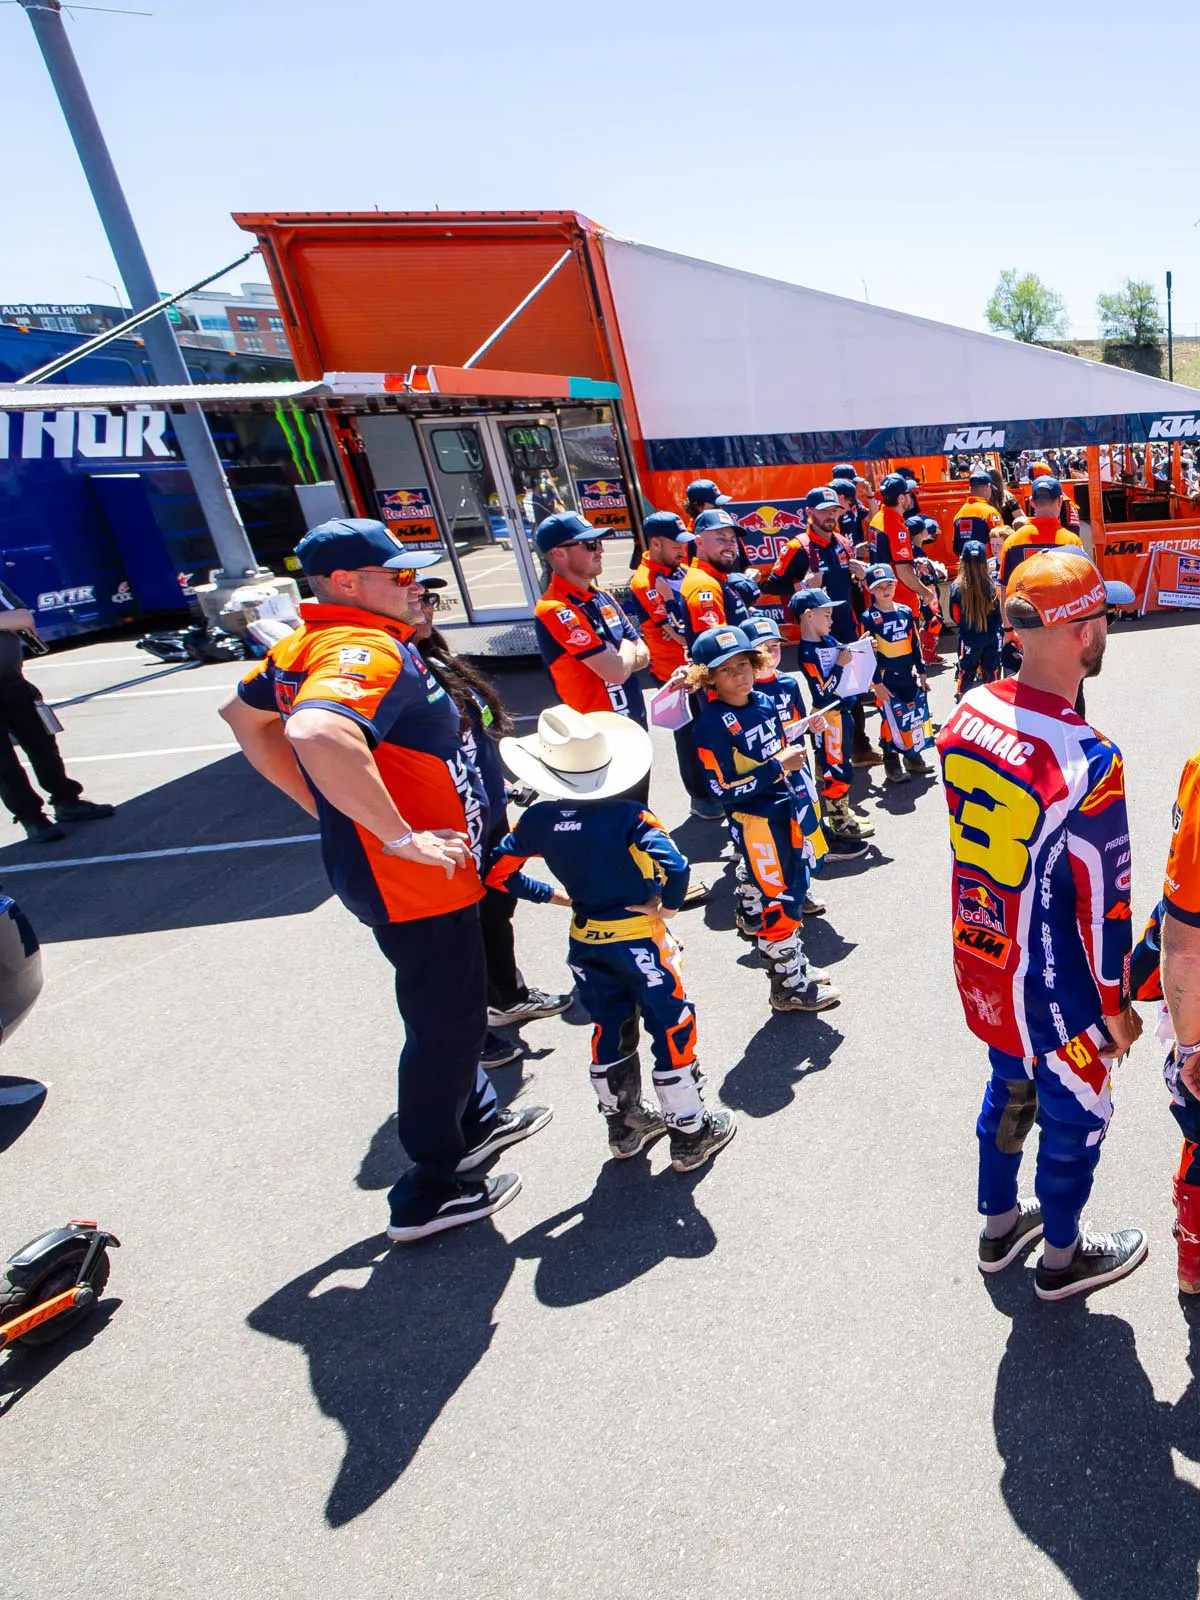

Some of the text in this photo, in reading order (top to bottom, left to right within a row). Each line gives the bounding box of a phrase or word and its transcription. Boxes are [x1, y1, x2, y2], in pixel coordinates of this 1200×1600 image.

[2, 306, 92, 315] ALTA MILE HIGH
[0, 410, 170, 458] HOR
[944, 426, 1005, 450] KTM
[383, 504, 433, 519] Red Bull
[583, 498, 605, 509] Red
[594, 514, 626, 525] KTM
[398, 524, 432, 537] KTM
[747, 537, 773, 560] ed
[1104, 540, 1143, 556] KTM
[38, 586, 95, 609] GYTR
[1044, 583, 1105, 622] RACING
[560, 611, 571, 620] 12
[883, 619, 909, 634] FLY
[902, 708, 925, 727] FLY
[744, 717, 777, 751] FLY
[827, 726, 842, 761] FLY
[952, 710, 1035, 767] TOMAC
[761, 739, 782, 760] KTM
[734, 778, 758, 797] FLY
[554, 821, 582, 832] KTM
[942, 752, 1042, 890] 3
[1105, 832, 1131, 851] PROGRE
[752, 842, 784, 887] FLY
[585, 930, 616, 940] FLY
[956, 928, 1004, 959] KTM
[629, 948, 663, 987] KTM
